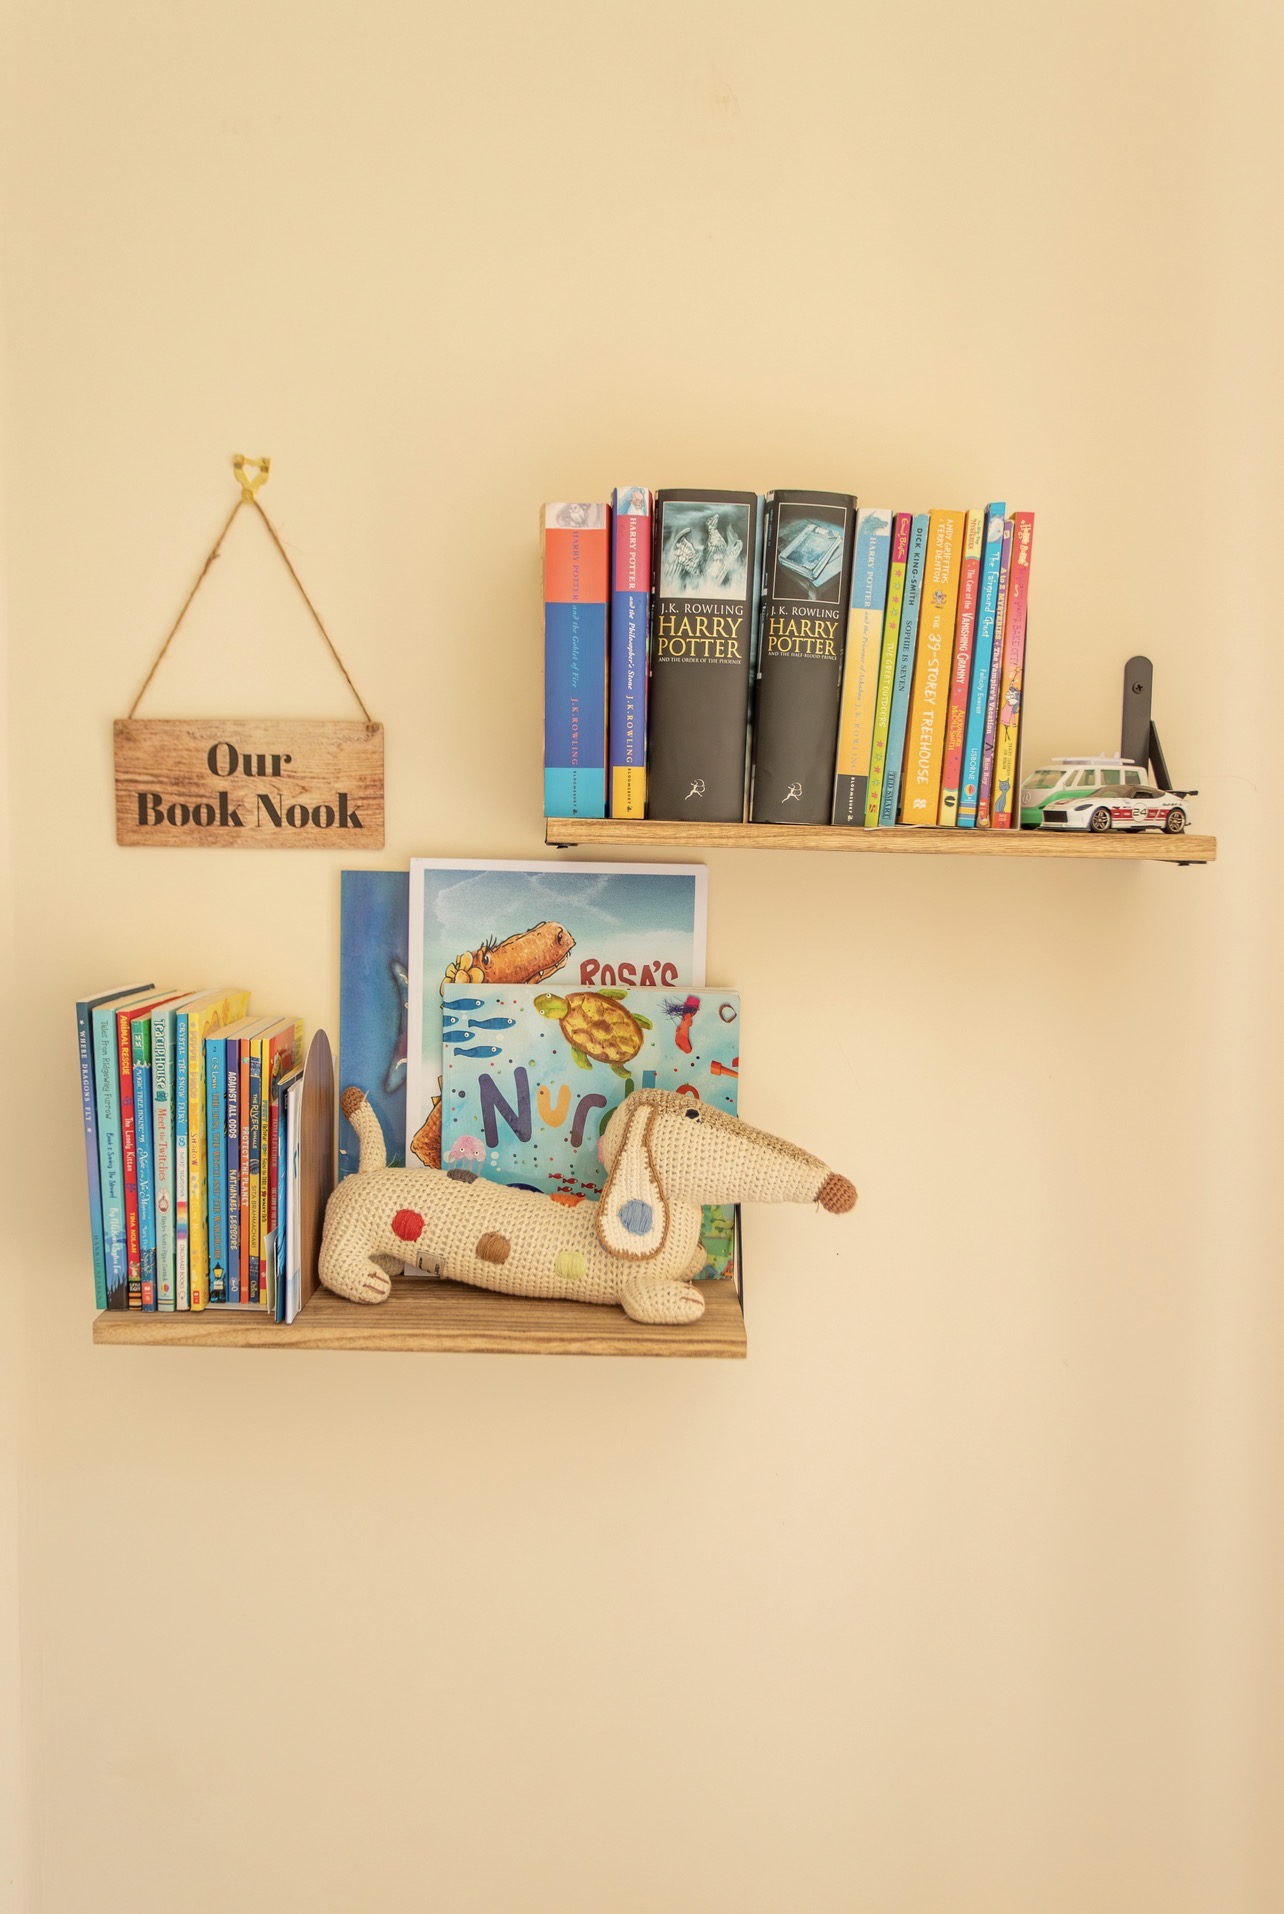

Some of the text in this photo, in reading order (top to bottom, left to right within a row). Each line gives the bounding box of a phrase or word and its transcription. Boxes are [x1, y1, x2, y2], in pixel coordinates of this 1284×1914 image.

[572, 531, 580, 561] HARRY
[866, 537, 877, 569] HARRY
[896, 517, 909, 560] Enid Blyton
[933, 523, 946, 583] TERRY DENTON
[941, 518, 954, 585] ANDY GRIFFITHS
[572, 565, 580, 601] POTTER
[908, 527, 924, 606] DICK KING-SMITH
[966, 568, 976, 580] The
[999, 575, 1006, 583] to
[626, 517, 637, 690] HARRY POTTER and the Philosopher's Stone
[864, 571, 873, 608] POTTER
[964, 580, 974, 593] Case
[981, 551, 1000, 639] The Fairground Ghost
[571, 604, 579, 620] and
[684, 603, 744, 616] ROWLING
[792, 607, 840, 619] ROWLING
[963, 600, 972, 610] the
[994, 593, 1004, 640] MYSTERIES
[571, 621, 579, 634] the
[658, 615, 743, 639] HARRY
[768, 618, 839, 639] HARRY
[862, 625, 870, 635] the
[960, 612, 974, 652] VANISHING
[571, 635, 579, 660] Goblet
[657, 637, 743, 659] POTTER
[767, 636, 837, 656] POTTER
[860, 636, 868, 664] Prisoner
[898, 620, 913, 692] SOPHIE IS SEVEN
[993, 647, 1001, 661] The
[571, 671, 580, 688] Fire
[879, 642, 895, 728] THE GREAT OUTDOORS
[956, 653, 969, 684] GRANNY
[988, 662, 999, 701] Vampire's
[916, 615, 942, 785] THE 39-STOREY TREEHOUSE
[975, 668, 987, 714] Felicity Everett
[955, 709, 966, 748] ALEXANDER
[986, 702, 996, 734] Vacation
[947, 730, 957, 751] SMITH
[206, 740, 293, 778] Our
[968, 747, 978, 780] USBORNE
[981, 757, 991, 785] Ron Roy
[136, 790, 363, 829] Book Nook
[883, 771, 896, 819] TED SMART
[1132, 807, 1147, 816] 24
[119, 1015, 131, 1076] ANIMAL RESCUE
[79, 1030, 92, 1122] WHERE DRAGONS FLY
[100, 1019, 112, 1120] Tales From Ridgeway Furrow
[177, 1022, 187, 1125] CRYSTAL THE SNOW FAIRY
[157, 1108, 167, 1130] Meet
[228, 1071, 237, 1139] AGAINST ALL ODDS
[250, 1104, 260, 1131] RIVER
[124, 1116, 135, 1172] The Lonely Kitten
[212, 1132, 220, 1148] THE
[158, 1142, 168, 1182] Twitches
[241, 1126, 250, 1207] PROTECT THE PLANET
[213, 1179, 221, 1196] AND
[229, 1169, 238, 1213] NATHANAEL
[213, 1197, 221, 1214] THE
[129, 1212, 138, 1254] TINA NOLAN
[214, 1214, 222, 1260] WARDROBE
